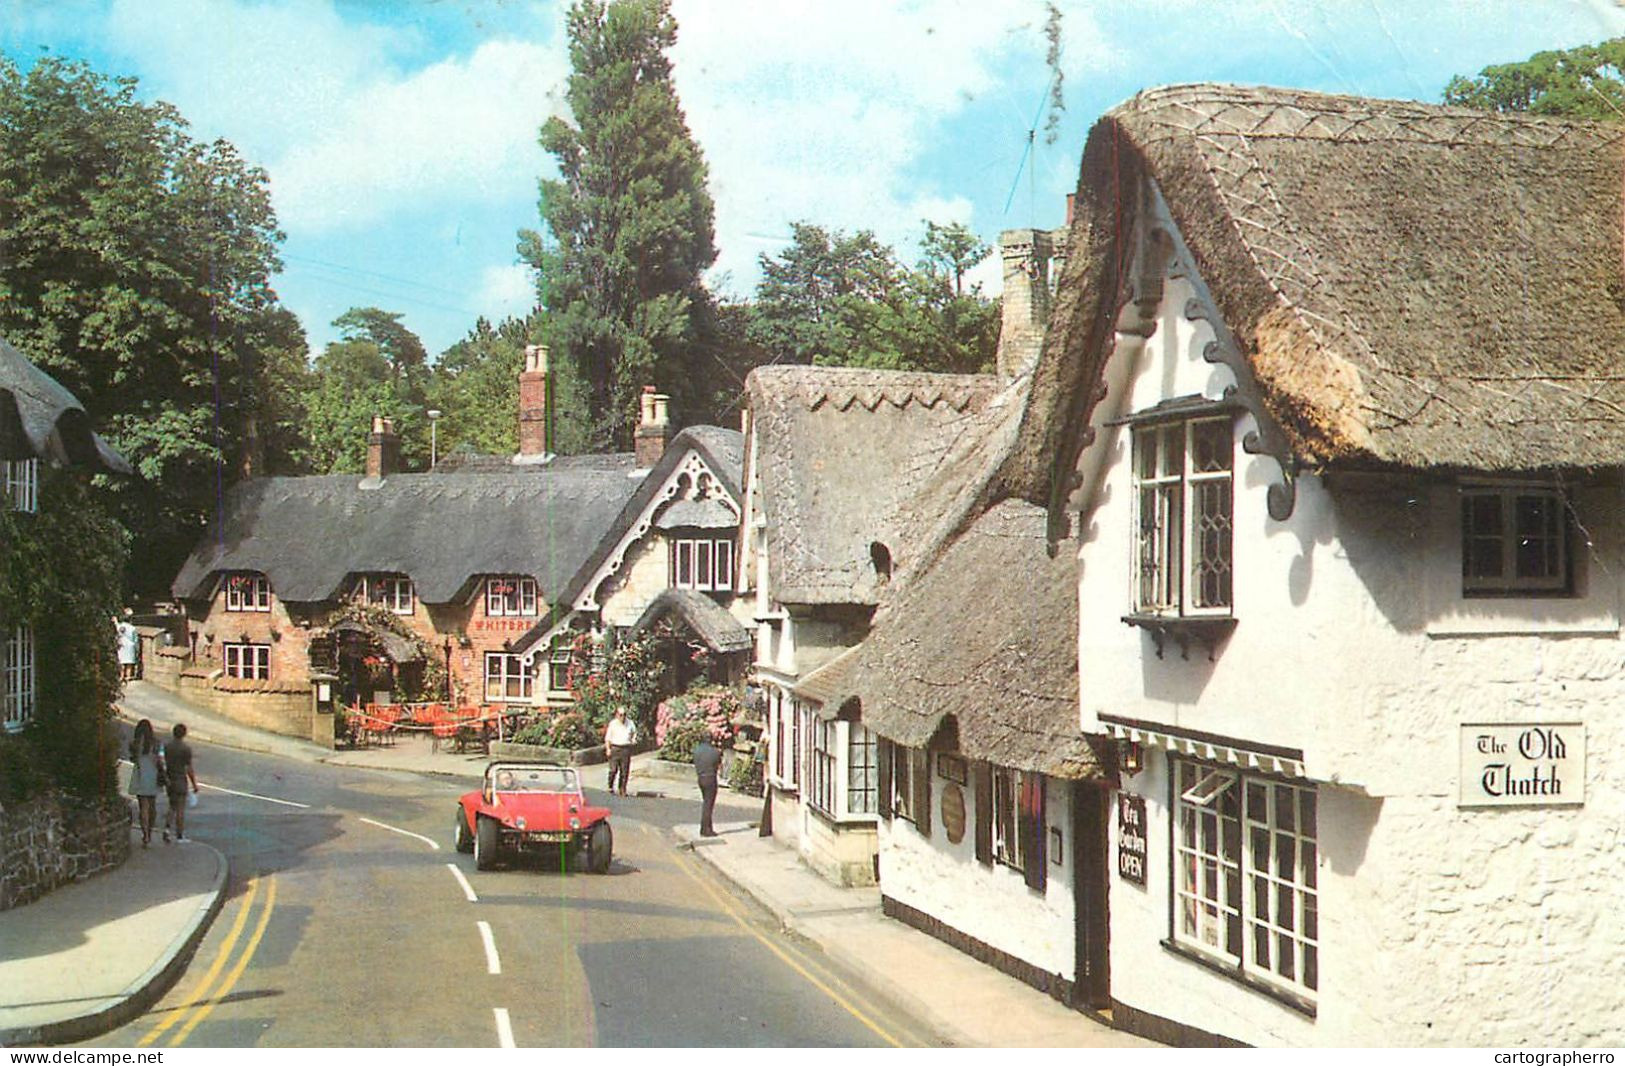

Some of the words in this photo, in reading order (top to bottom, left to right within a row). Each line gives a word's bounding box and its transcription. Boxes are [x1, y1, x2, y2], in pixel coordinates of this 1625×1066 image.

[475, 620, 538, 631] WHITBRE
[1477, 735, 1507, 754] The
[1518, 728, 1566, 760] Old
[1482, 763, 1561, 797] Thatch
[1122, 798, 1139, 826] Tea
[1120, 852, 1143, 879] OPEN
